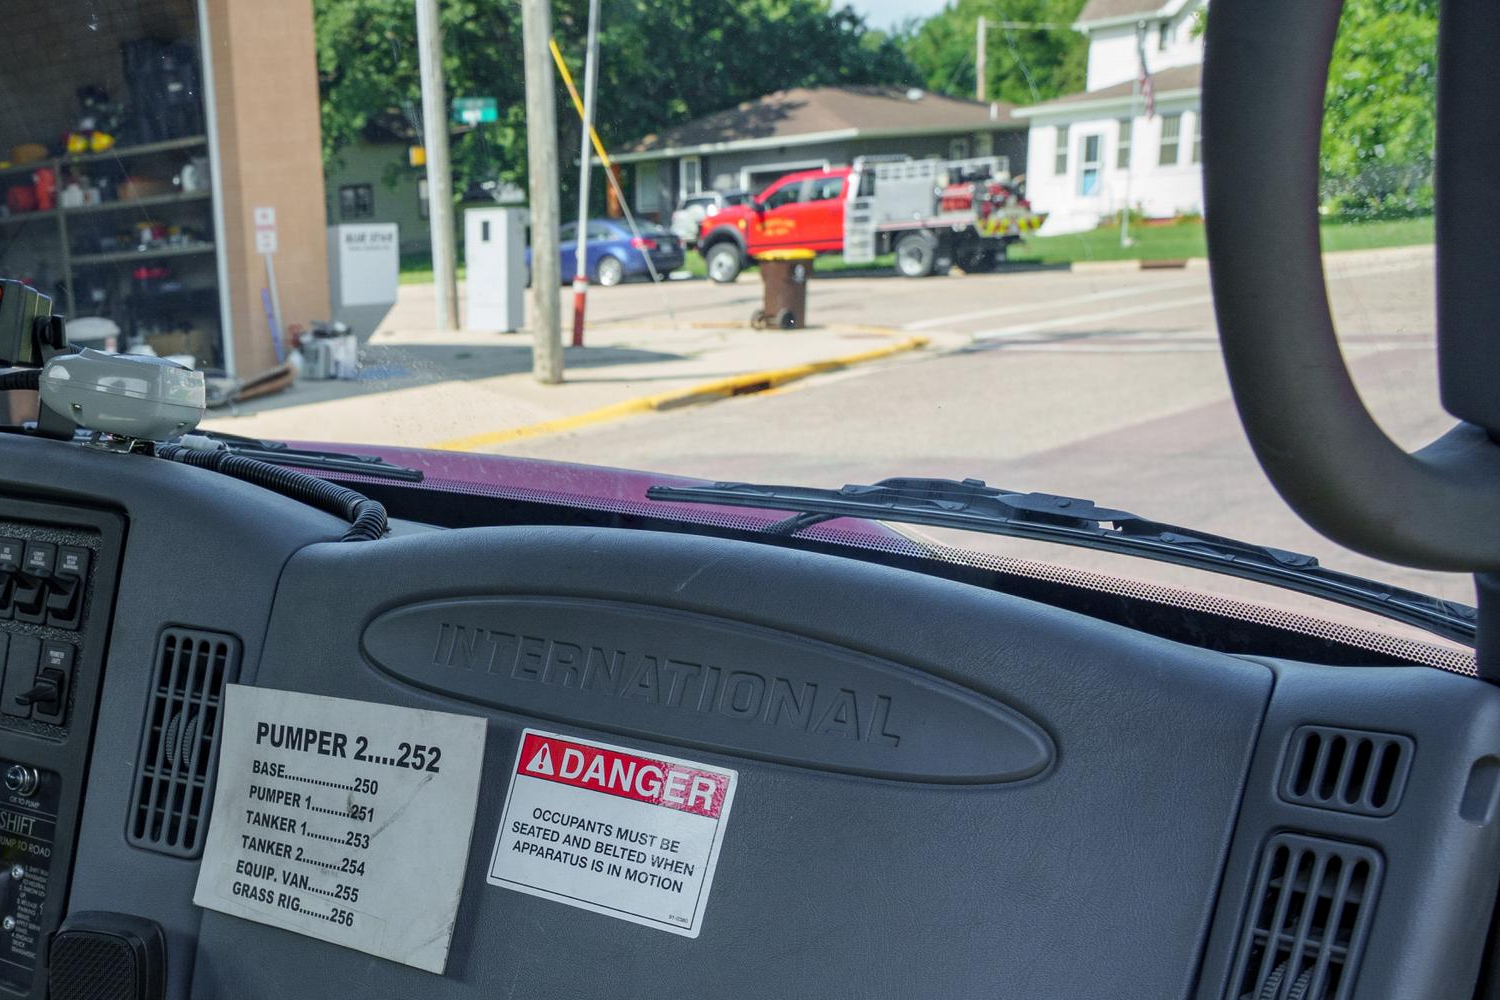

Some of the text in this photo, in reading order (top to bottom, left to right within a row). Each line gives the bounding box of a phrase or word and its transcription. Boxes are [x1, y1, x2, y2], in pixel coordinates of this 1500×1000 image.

[431, 622, 903, 748] INTERNATIONAL
[255, 722, 348, 758] PUMPER
[560, 748, 718, 810] DANGER
[249, 786, 301, 808] PUMPER
[246, 810, 296, 833] TANKER
[532, 808, 680, 854] OCCUPANTS MUST BE
[18, 840, 28, 852] TO
[28, 842, 50, 858] ROAD
[242, 834, 292, 858] TANKER
[512, 822, 694, 877] SEATED AND BELTED WHEN
[236, 860, 277, 882] EQUIP.
[512, 840, 684, 894] APPARATUS IS IN MOTION
[232, 882, 274, 904] GRASS
